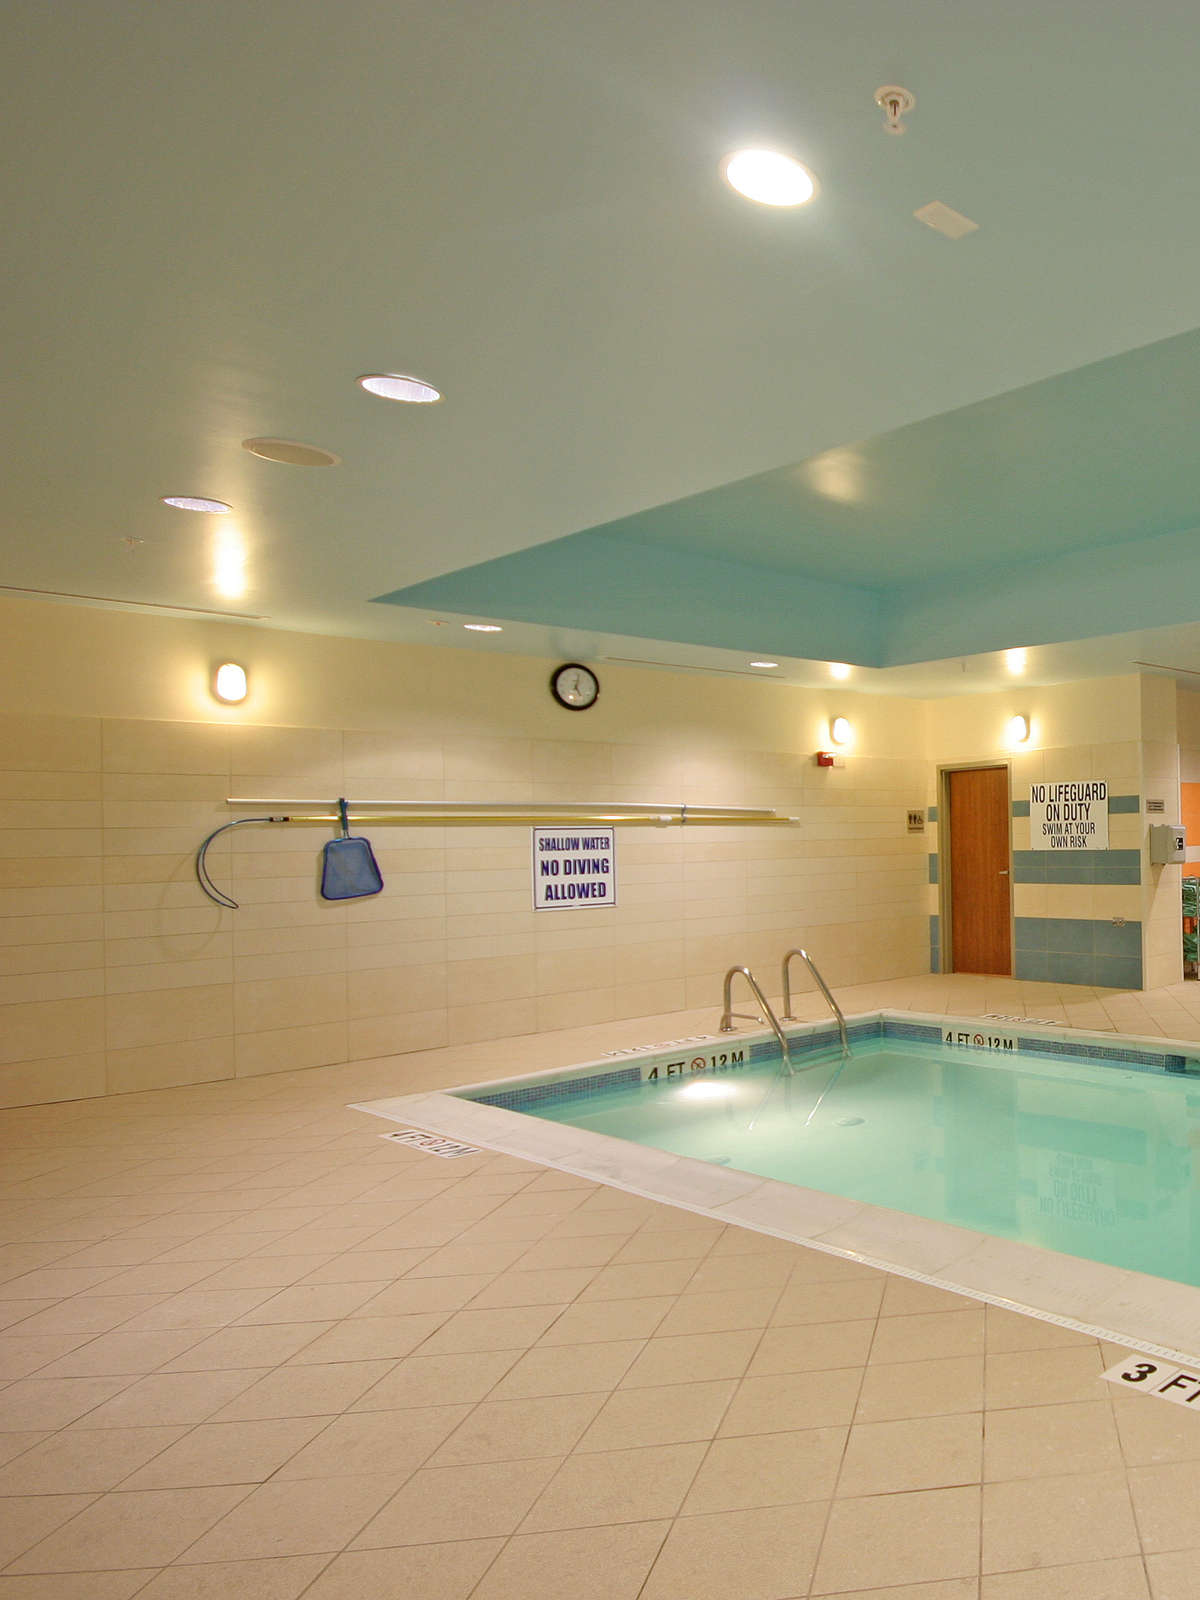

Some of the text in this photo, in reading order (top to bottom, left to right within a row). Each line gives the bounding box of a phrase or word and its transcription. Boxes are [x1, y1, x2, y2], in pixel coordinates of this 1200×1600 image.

[1032, 783, 1106, 803] NO LIFEGUARD
[1046, 803, 1091, 821] ON DUTY
[1042, 822, 1095, 835] SWIM AT YOUR
[539, 836, 610, 851] SHALLOW WATER
[1051, 835, 1087, 848] OWN RISK
[541, 858, 609, 876] NO DIVING
[544, 882, 607, 901] ALLOWED
[1121, 1363, 1157, 1383] 3
